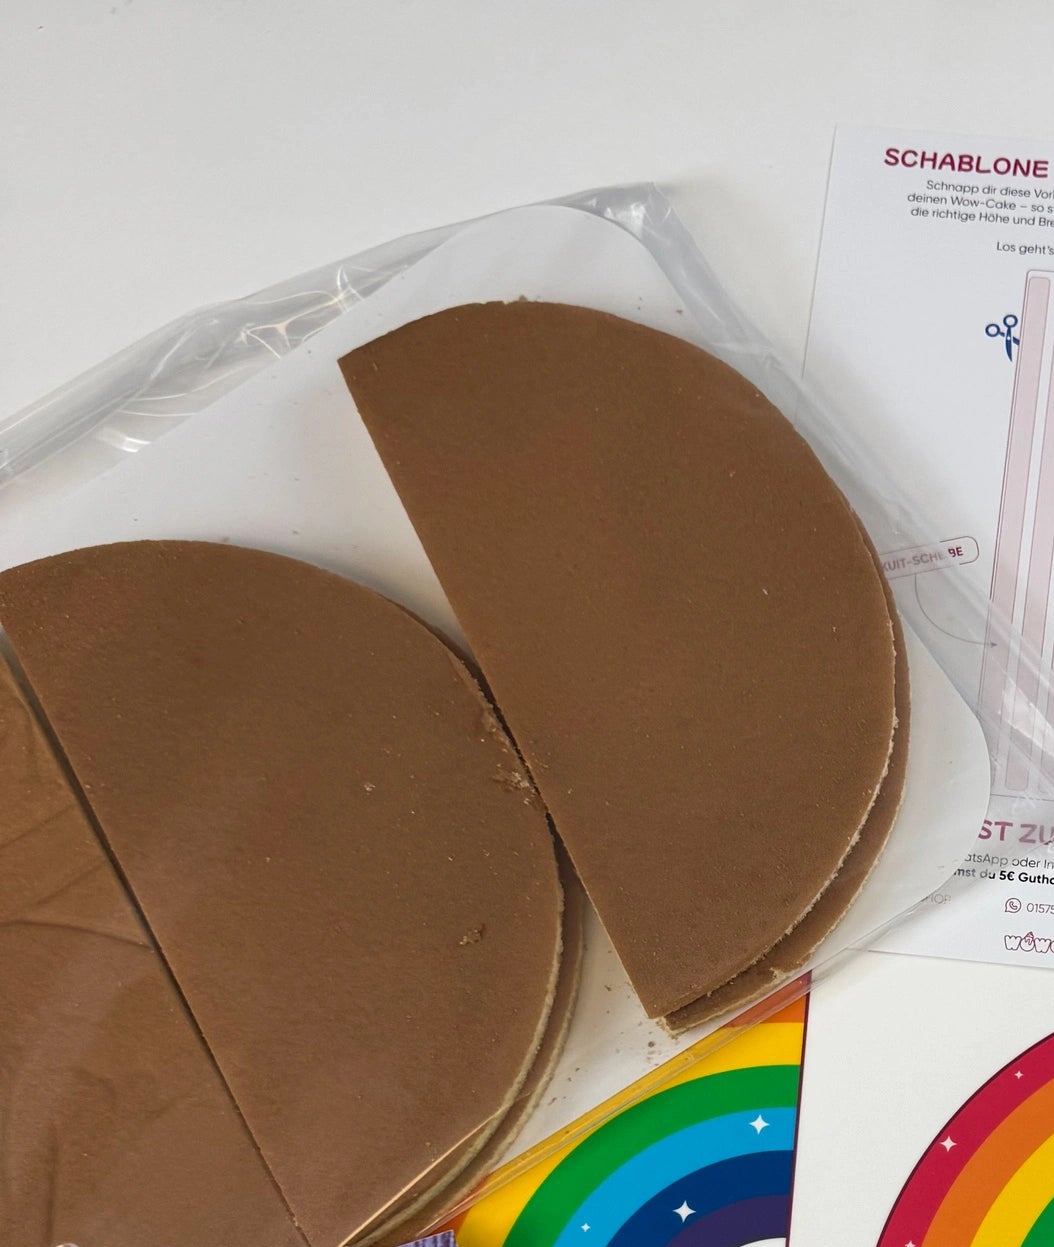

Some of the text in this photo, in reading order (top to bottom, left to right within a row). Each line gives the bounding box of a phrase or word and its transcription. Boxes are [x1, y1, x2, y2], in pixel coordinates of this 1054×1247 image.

[883, 147, 1049, 179] SCHABLONE
[926, 180, 979, 196] Schnapp
[982, 184, 997, 195] dir
[1000, 186, 1031, 198] diese
[907, 192, 948, 205] deinen
[950, 196, 1016, 211] Wow-Cake
[1031, 203, 1044, 213] so
[910, 207, 930, 218] die
[932, 208, 976, 224] richtige
[979, 211, 1011, 224] Höhe
[1012, 214, 1036, 226] und
[996, 241, 1016, 253] Los
[1012, 857, 1041, 869] oder
[979, 868, 997, 880] du
[999, 870, 1015, 881] 5€
